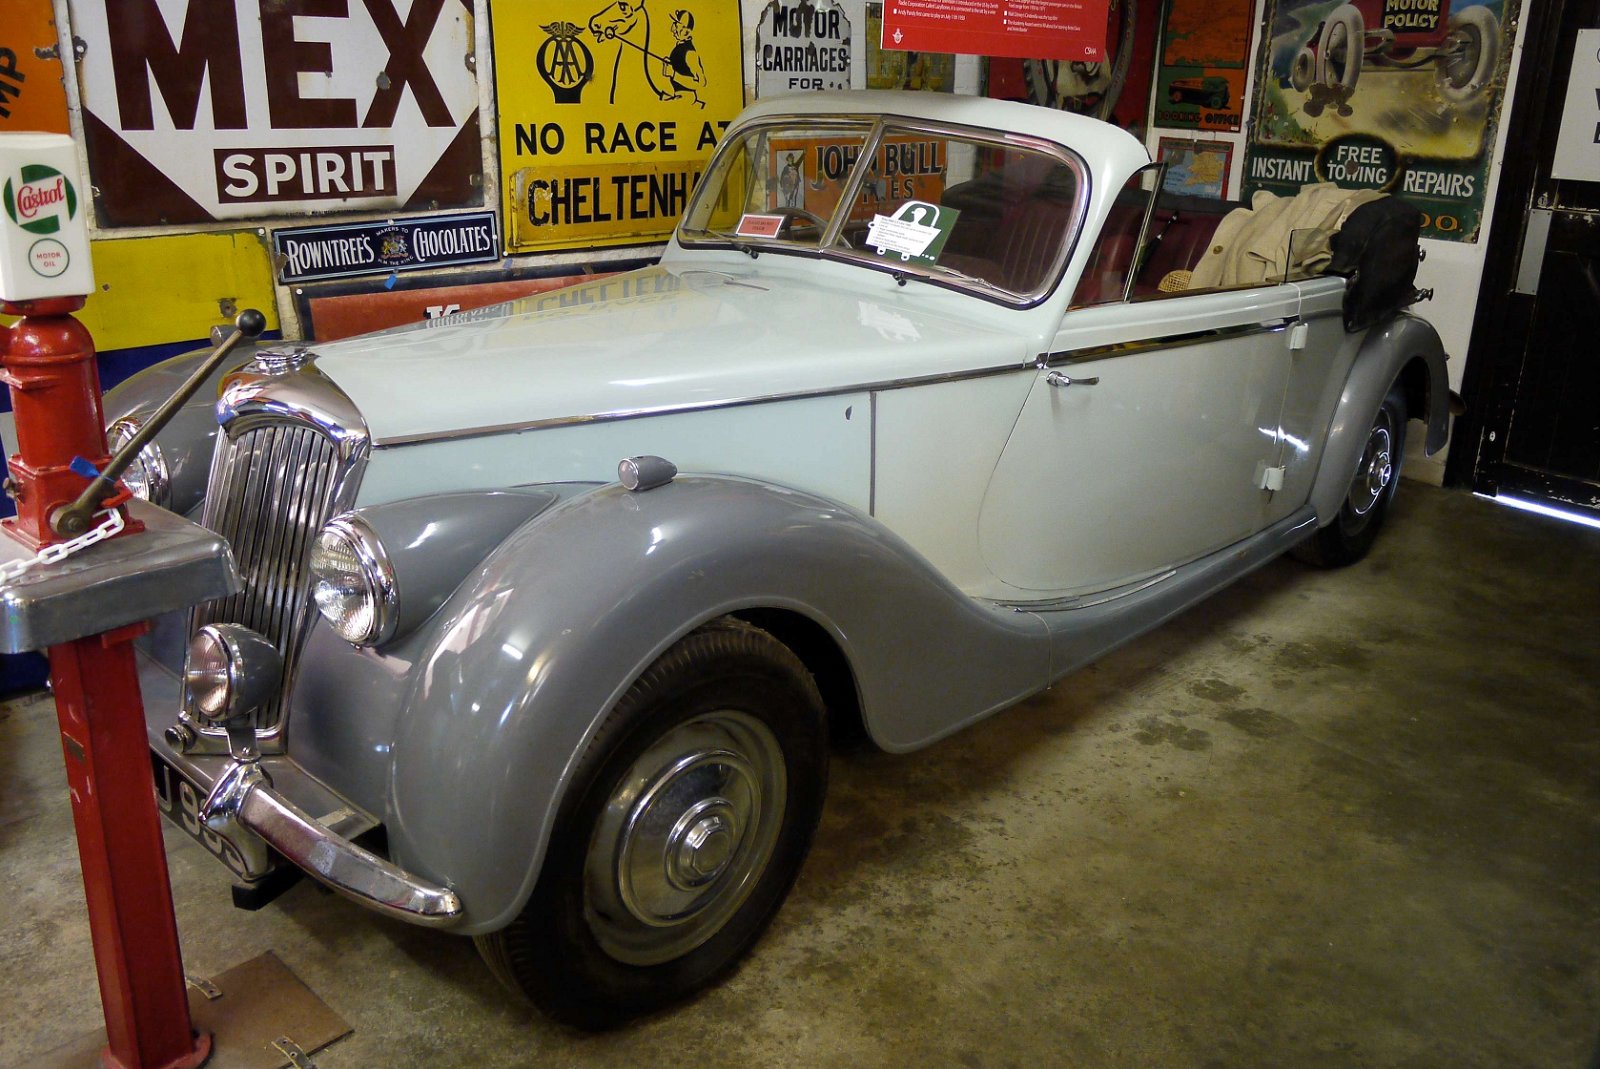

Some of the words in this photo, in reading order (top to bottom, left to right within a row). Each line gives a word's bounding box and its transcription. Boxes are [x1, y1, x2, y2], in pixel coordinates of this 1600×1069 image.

[772, 6, 840, 39] MOTOR
[1384, 13, 1439, 28] POLICY
[104, 0, 457, 131] MEX
[763, 44, 847, 72] CARRIAGES
[789, 77, 823, 90] FOR
[515, 122, 565, 155] NO
[585, 121, 677, 154] RACE
[885, 141, 944, 177] BULL
[1337, 145, 1383, 164] FREE
[222, 151, 392, 197] SPIRIT
[1252, 157, 1312, 182] INSTANT
[17, 178, 64, 218] Castrol
[1403, 170, 1475, 198] REPAIRS
[376, 226, 400, 236] MAKERS
[36, 252, 61, 260] MOTOR
[286, 234, 375, 275] ROWNTREE'S
[413, 226, 490, 262] CHOCOLATES
